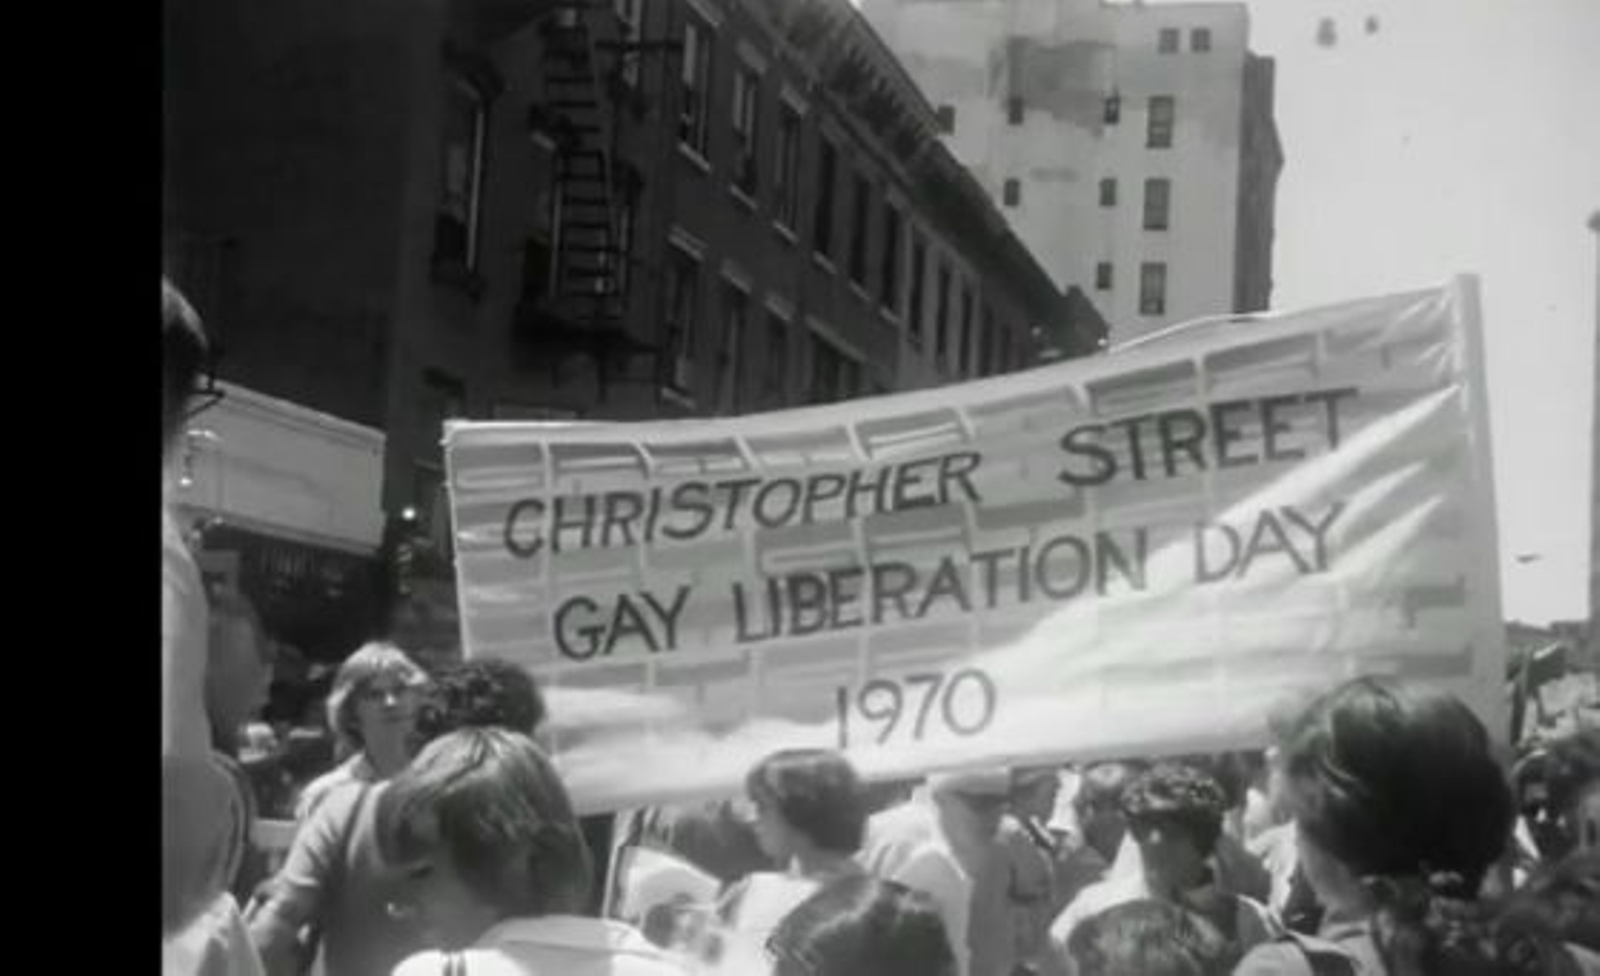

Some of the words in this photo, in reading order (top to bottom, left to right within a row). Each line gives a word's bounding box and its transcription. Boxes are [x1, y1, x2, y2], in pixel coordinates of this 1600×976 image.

[502, 452, 982, 558] CHRISTOPHER
[1057, 387, 1358, 486] STREET
[553, 585, 690, 661] GAY
[733, 525, 1148, 644] LIBERATION
[1194, 501, 1346, 585] DAY
[837, 667, 996, 749] 1970
